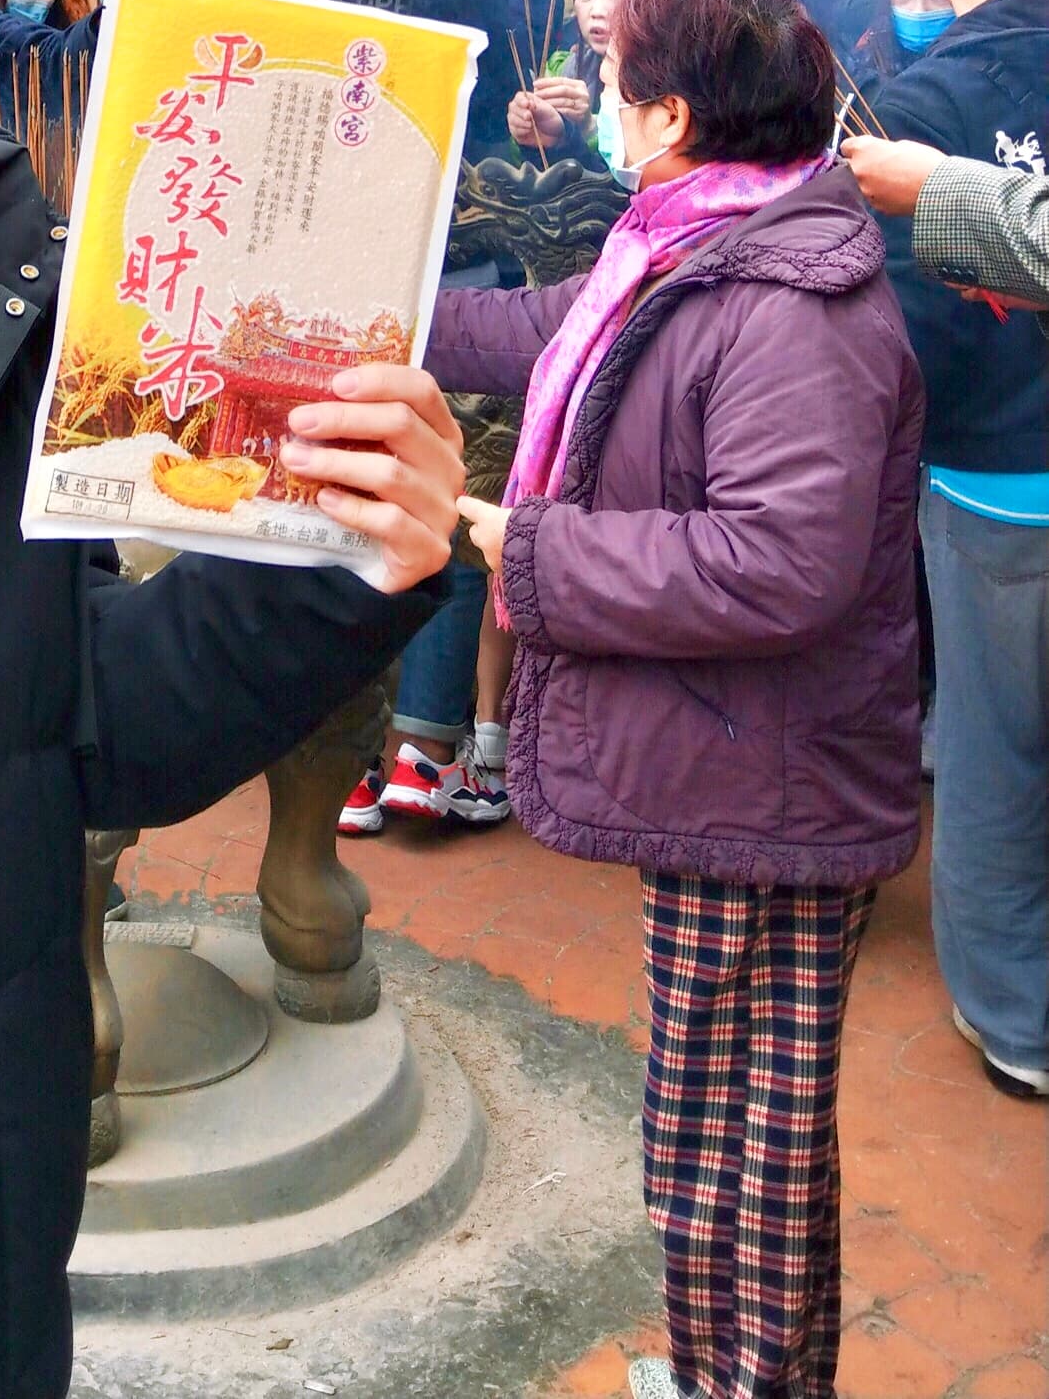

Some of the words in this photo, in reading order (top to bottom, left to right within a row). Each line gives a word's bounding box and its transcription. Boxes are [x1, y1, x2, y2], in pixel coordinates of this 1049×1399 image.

[338, 42, 381, 144] 紫南宮
[54, 473, 131, 503] 製造日期
